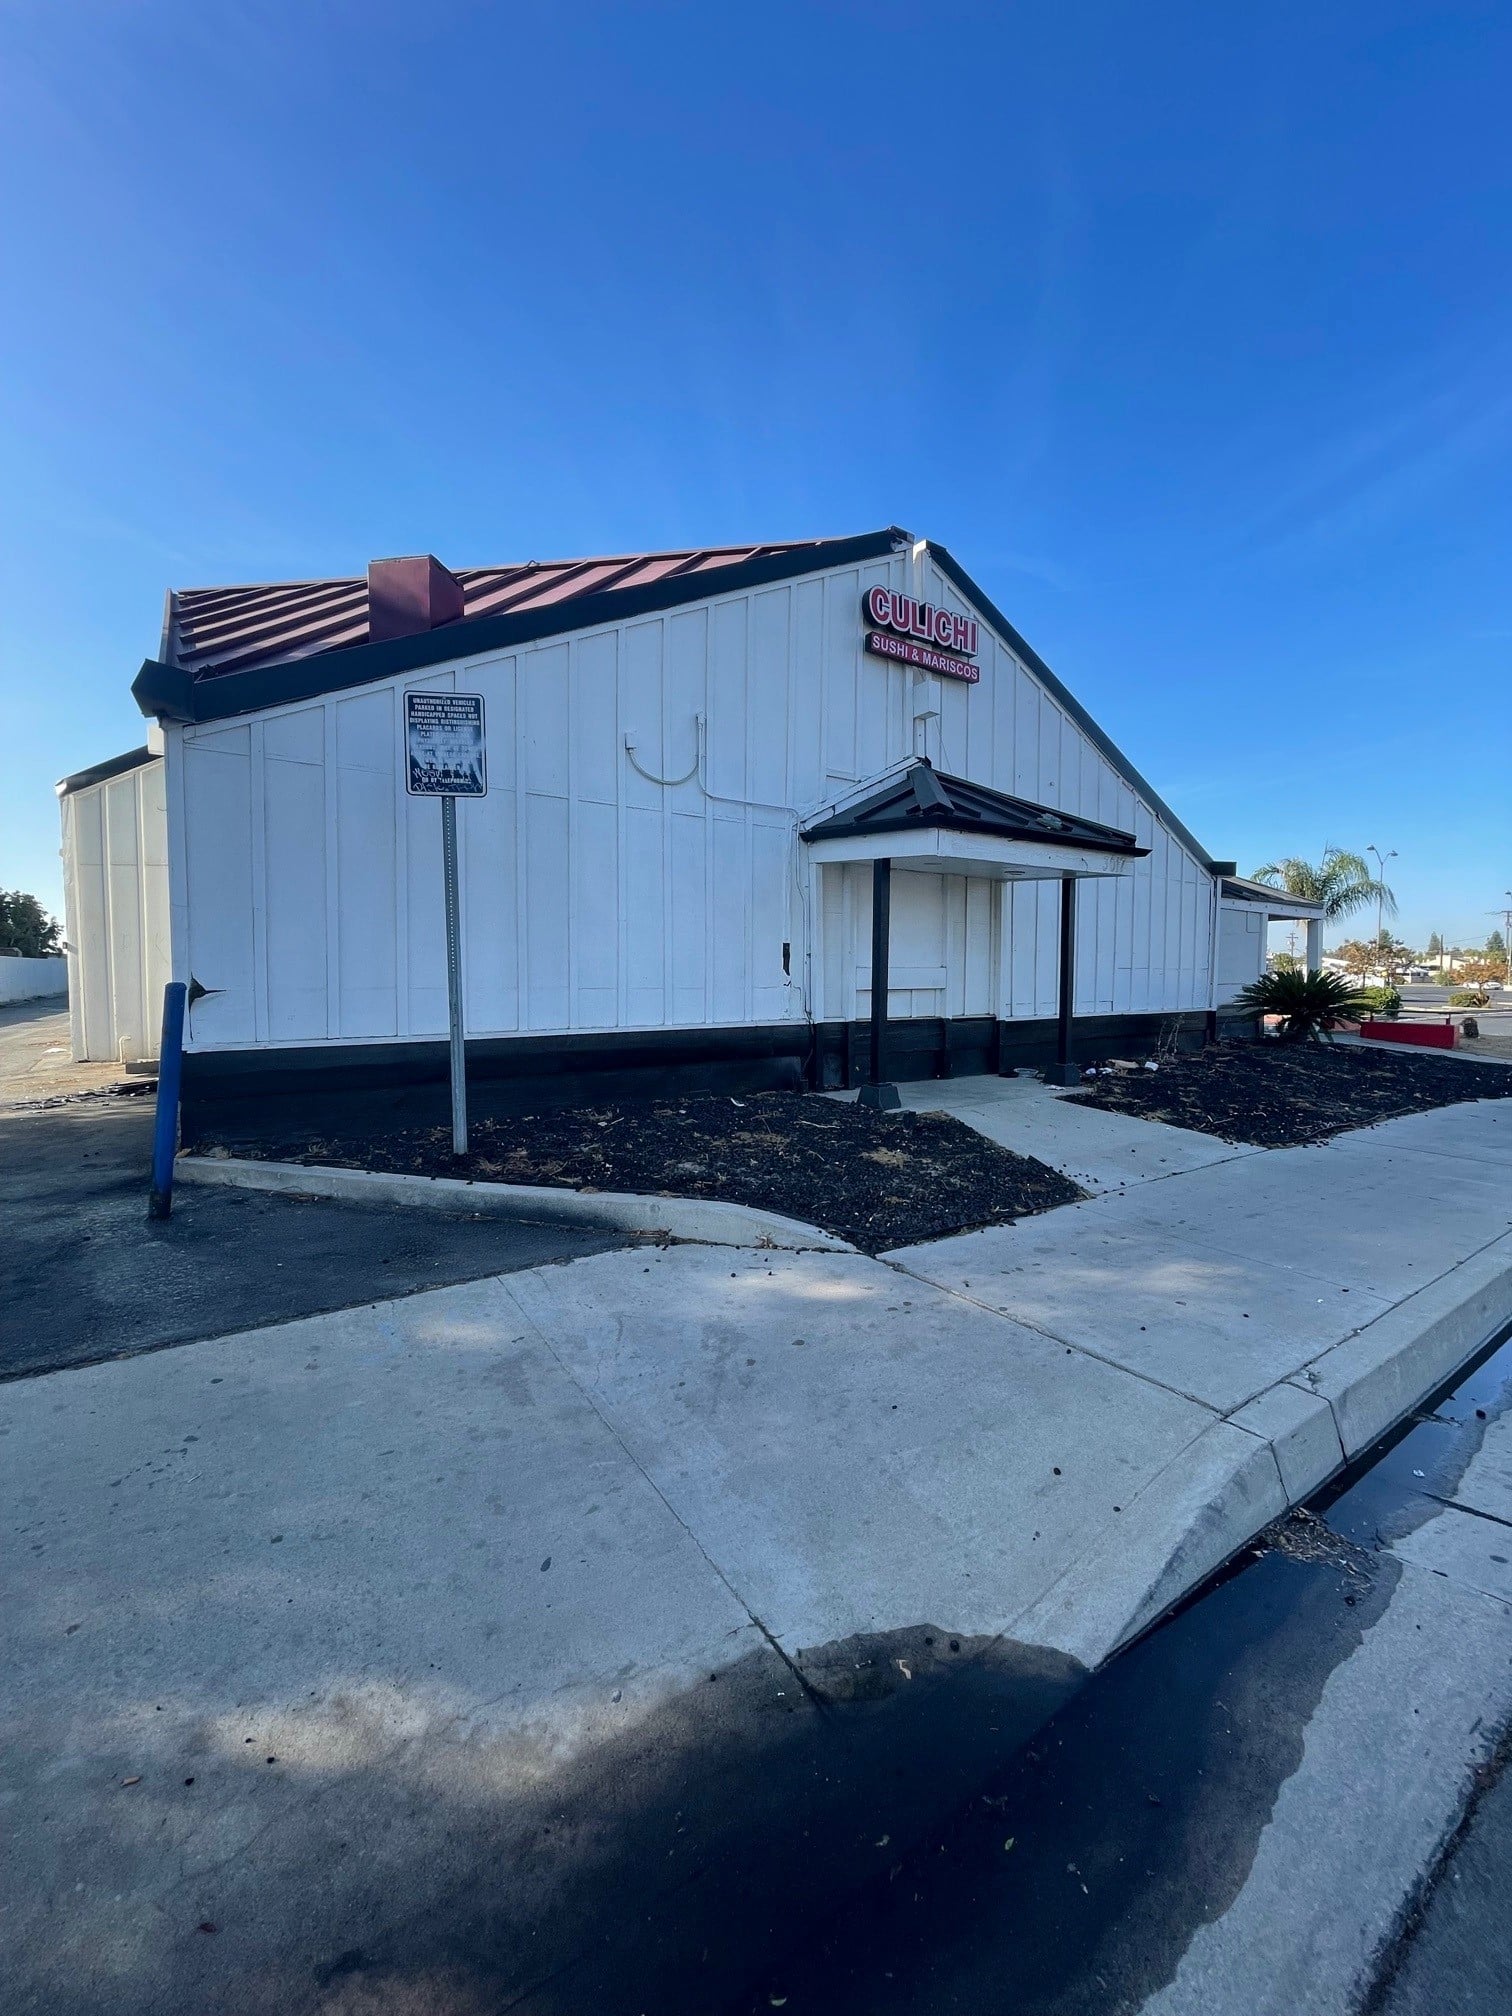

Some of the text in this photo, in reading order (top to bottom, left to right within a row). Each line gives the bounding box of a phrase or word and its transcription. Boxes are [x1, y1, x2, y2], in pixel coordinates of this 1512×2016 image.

[869, 584, 979, 655] CULICHI
[872, 635, 978, 680] SUSHI & MARISCOS
